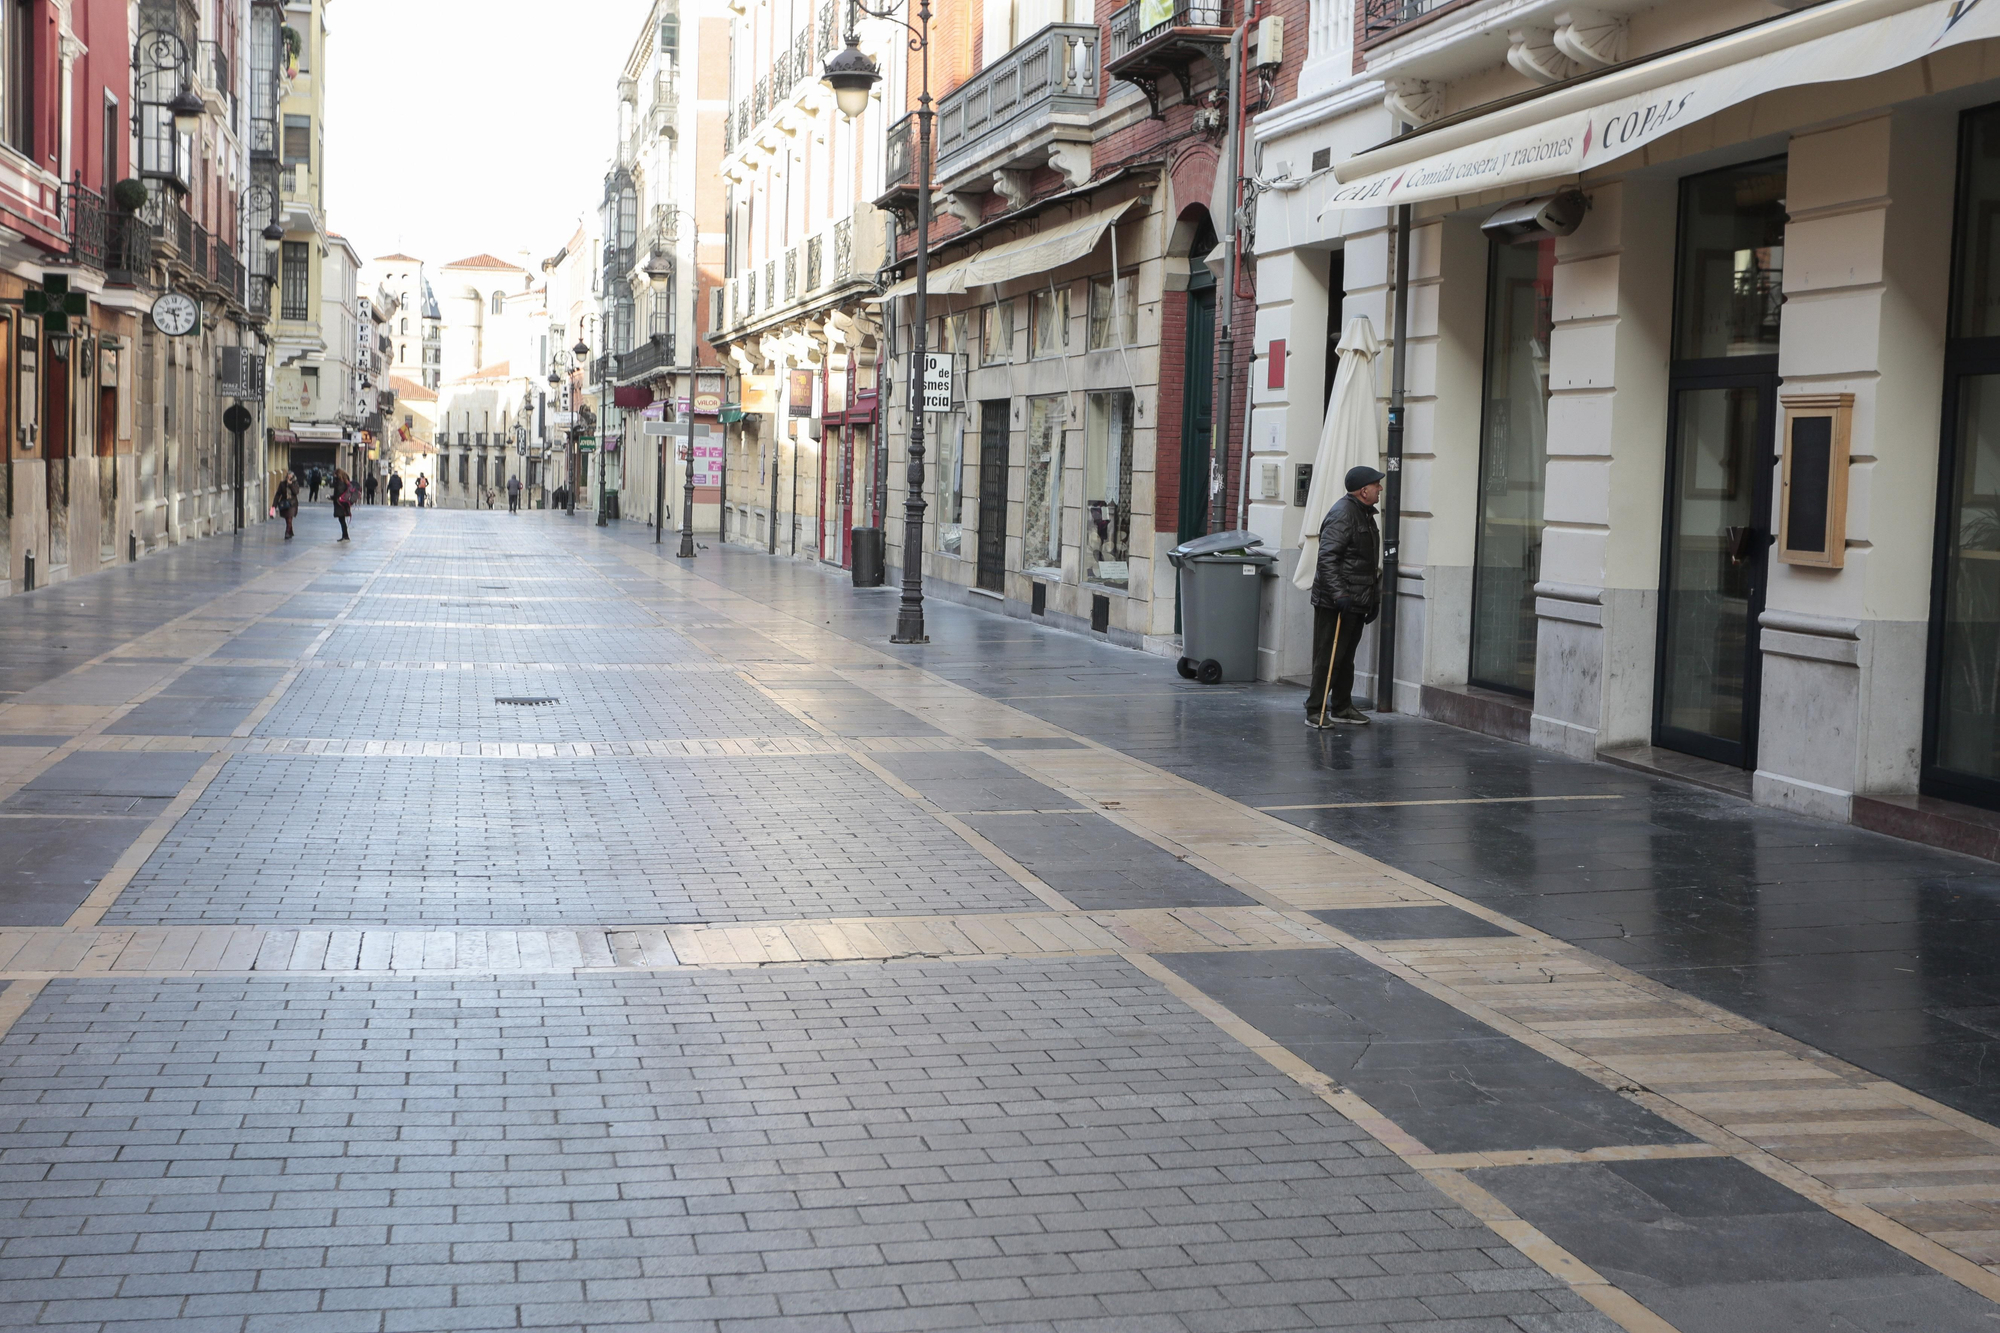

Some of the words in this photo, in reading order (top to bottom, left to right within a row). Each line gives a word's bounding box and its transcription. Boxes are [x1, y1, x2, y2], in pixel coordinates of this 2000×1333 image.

[1602, 89, 1696, 149] COPAS
[1406, 162, 1454, 189] Comida
[1456, 156, 1497, 179] casera
[1496, 154, 1510, 176] y
[1511, 136, 1574, 167] raciones
[358, 301, 369, 406] CAFETERA
[912, 354, 937, 372] jo
[938, 368, 950, 378] de
[911, 393, 949, 409] rcía
